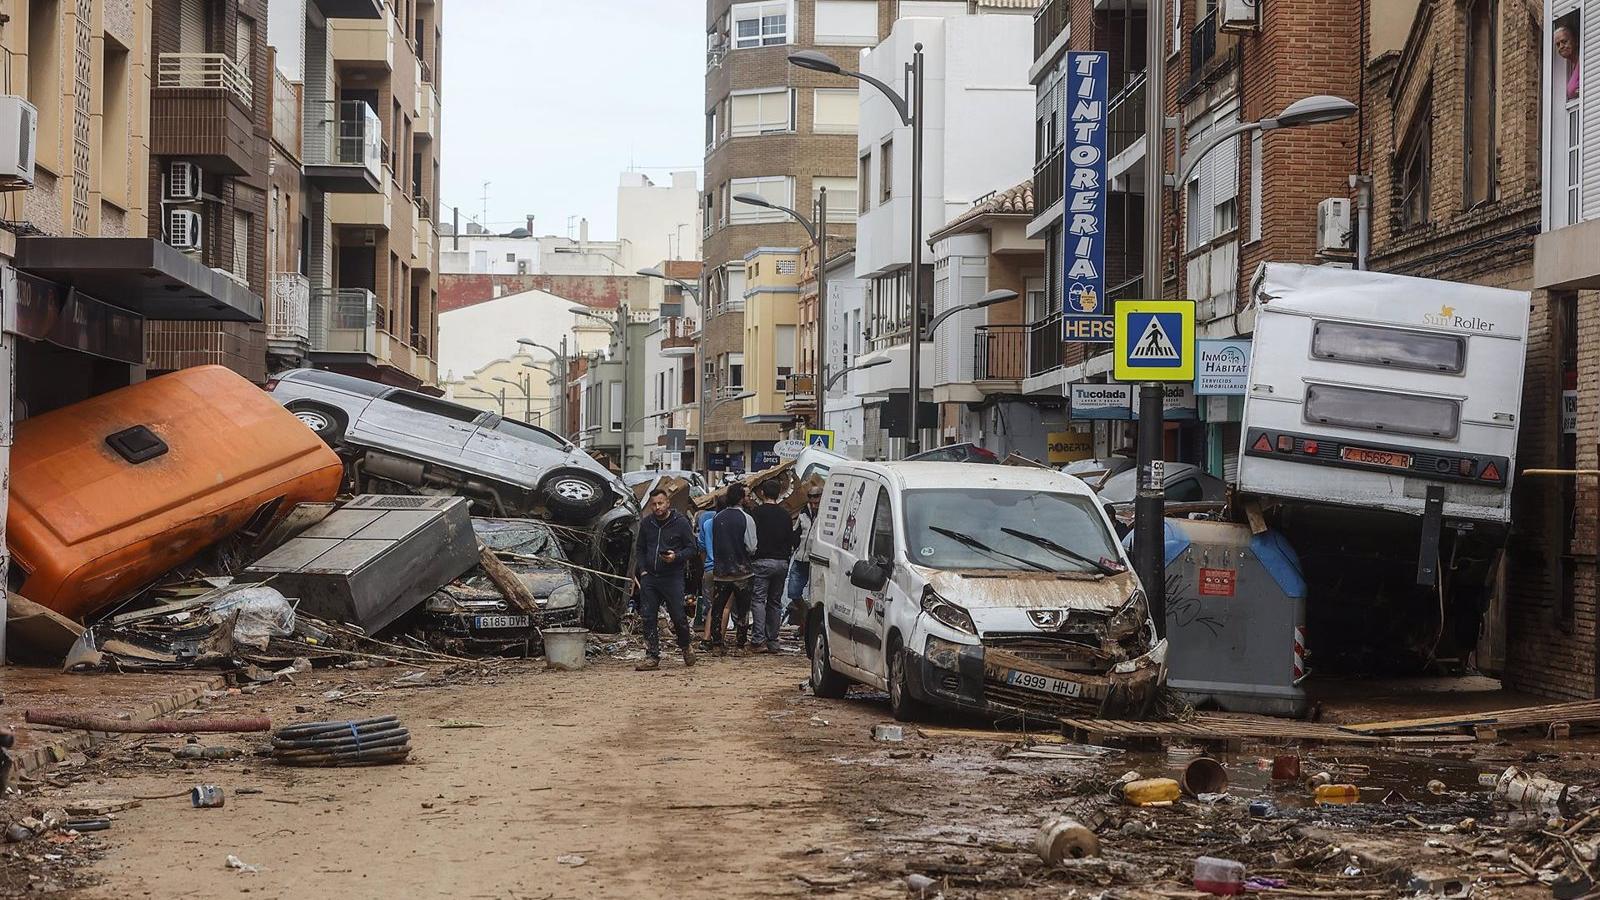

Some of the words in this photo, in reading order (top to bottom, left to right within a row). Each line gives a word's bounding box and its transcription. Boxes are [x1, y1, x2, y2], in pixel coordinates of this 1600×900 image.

[1068, 54, 1101, 280] TINTORERIA
[1065, 320, 1114, 338] HERS
[1423, 312, 1448, 326] Sun
[1454, 315, 1495, 331] Roller
[1202, 350, 1228, 362] INMO
[1075, 388, 1126, 399] Tucolada
[1564, 396, 1578, 413] VEN
[483, 616, 507, 628] 6185
[509, 616, 527, 627] DVR
[1015, 673, 1047, 690] 4999
[1052, 681, 1077, 696] HHJ
